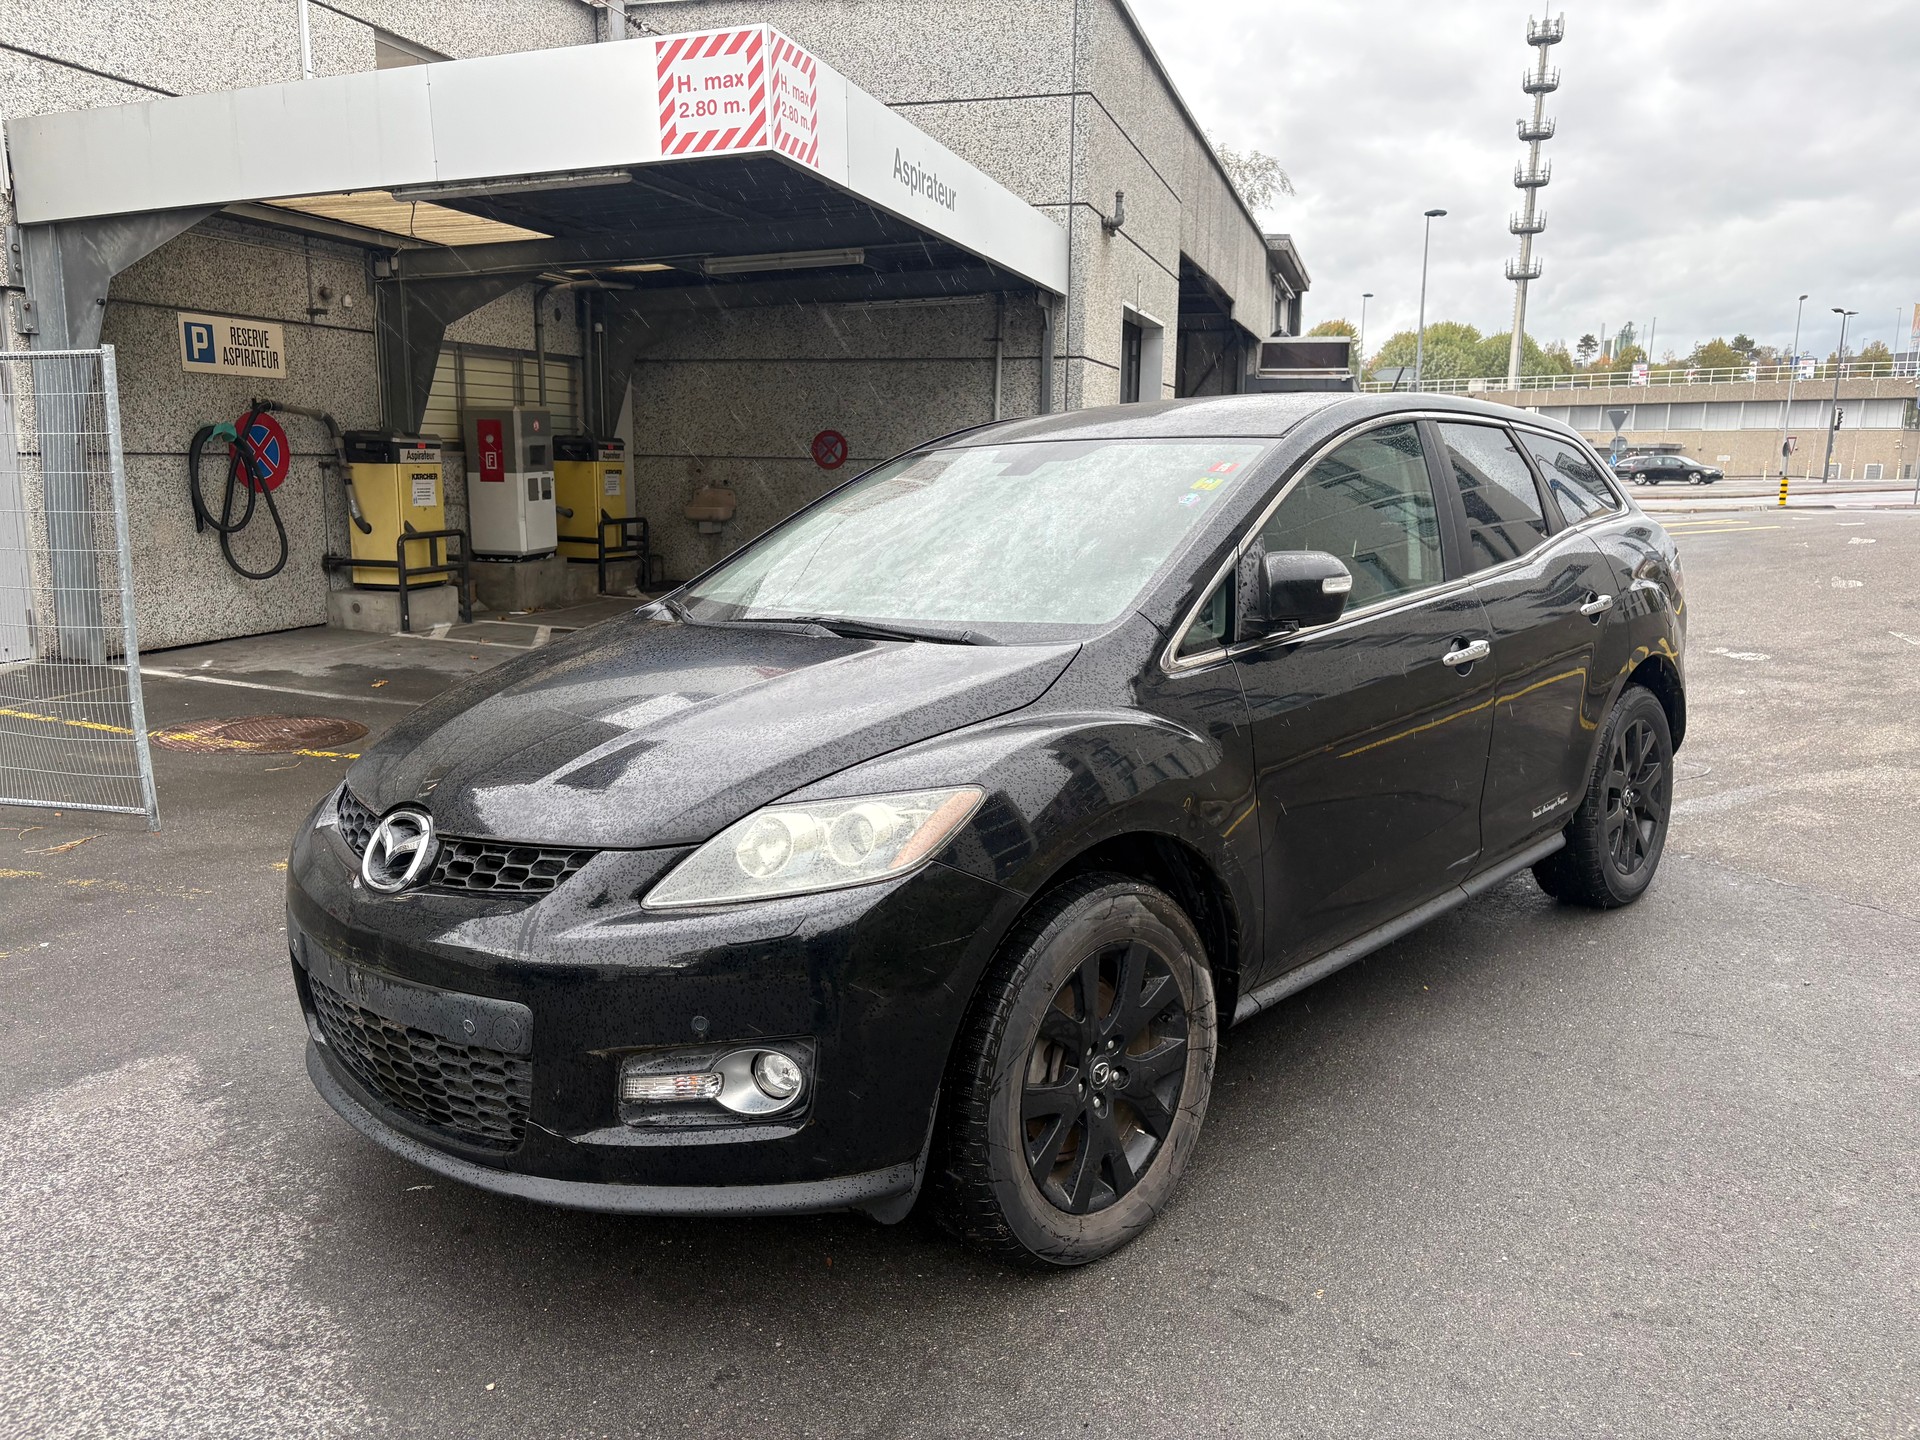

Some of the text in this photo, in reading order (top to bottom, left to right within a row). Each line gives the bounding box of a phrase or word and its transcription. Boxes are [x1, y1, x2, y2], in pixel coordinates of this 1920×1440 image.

[677, 73, 744, 93] H. max
[781, 73, 809, 107] H. max
[679, 99, 746, 118] 2.80 m.
[782, 101, 810, 131] 2.80 m.
[893, 147, 957, 212] Aspirateur
[191, 326, 208, 359] P
[229, 326, 270, 349] RESERVE
[223, 346, 280, 369] ASPIRATEUR
[406, 450, 435, 461] Aspirateur
